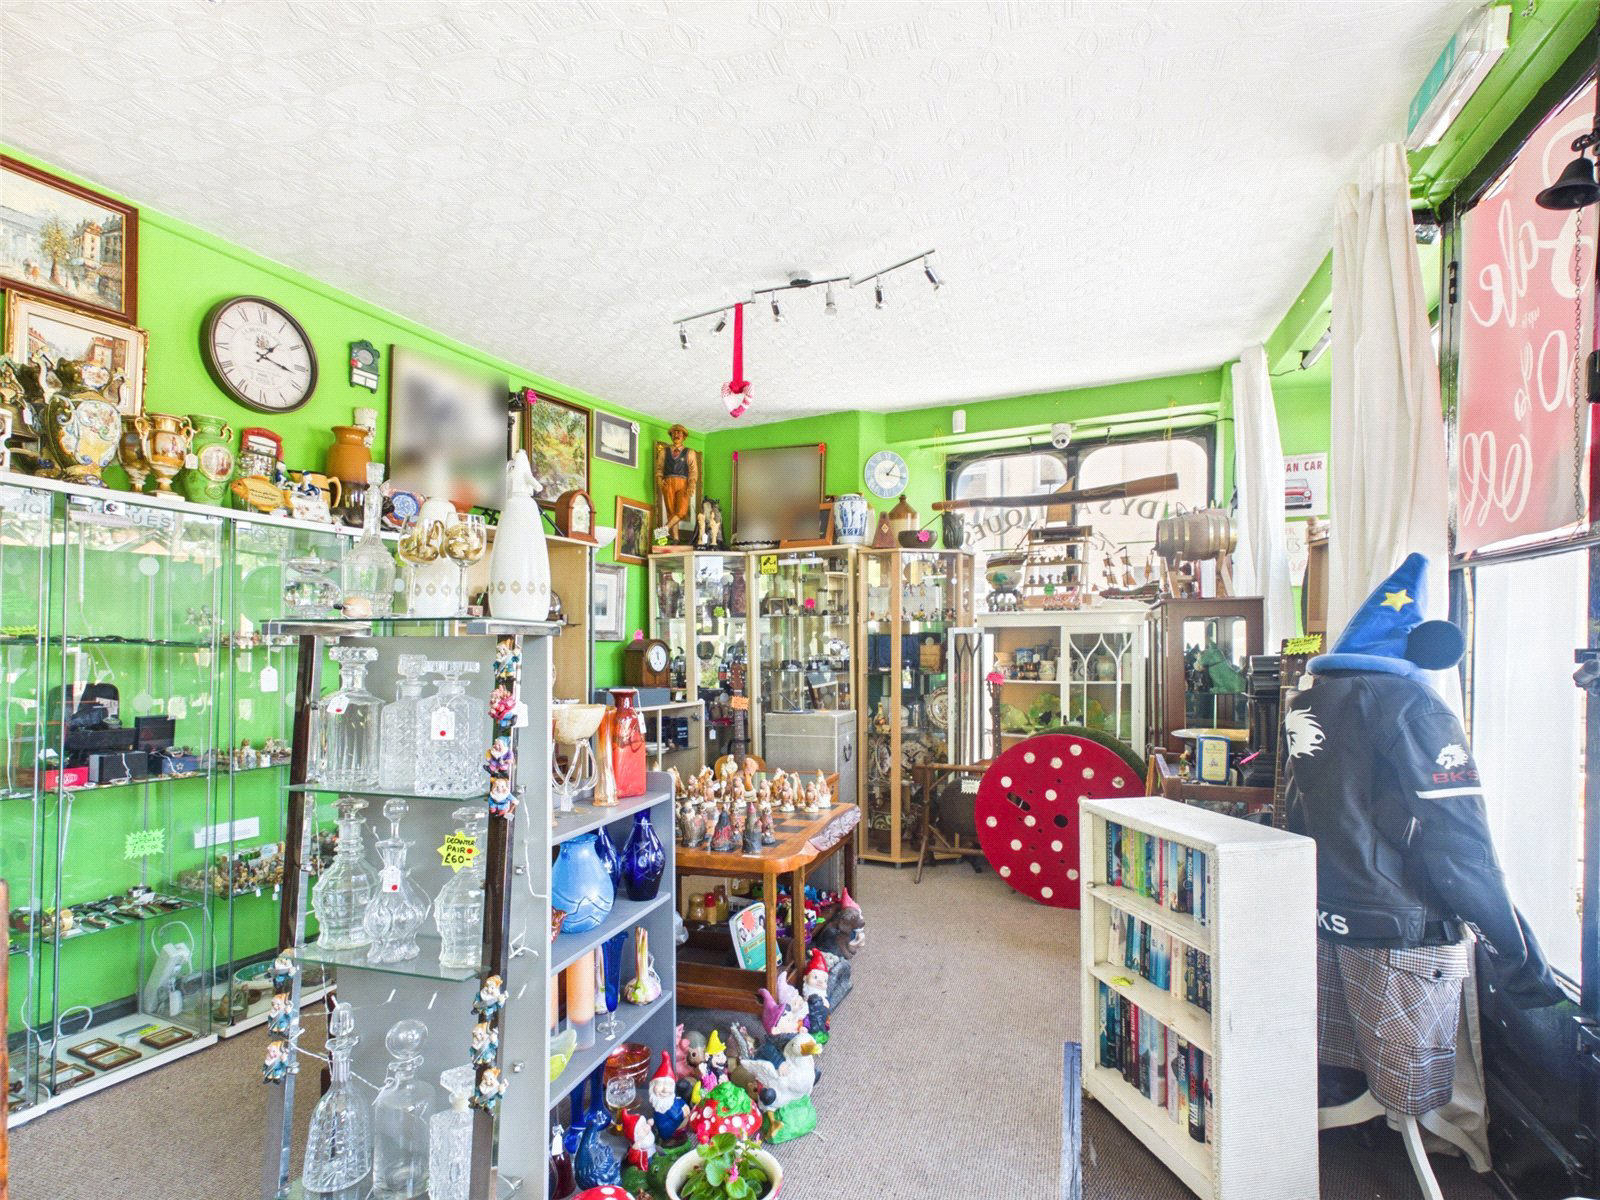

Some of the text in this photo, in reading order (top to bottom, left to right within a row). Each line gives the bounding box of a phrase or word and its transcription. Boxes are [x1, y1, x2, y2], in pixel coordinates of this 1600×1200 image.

[1304, 461, 1323, 472] CAR
[446, 845, 466, 854] PAIR
[1316, 909, 1349, 935] KS
[1189, 1103, 1199, 1127] WIN
